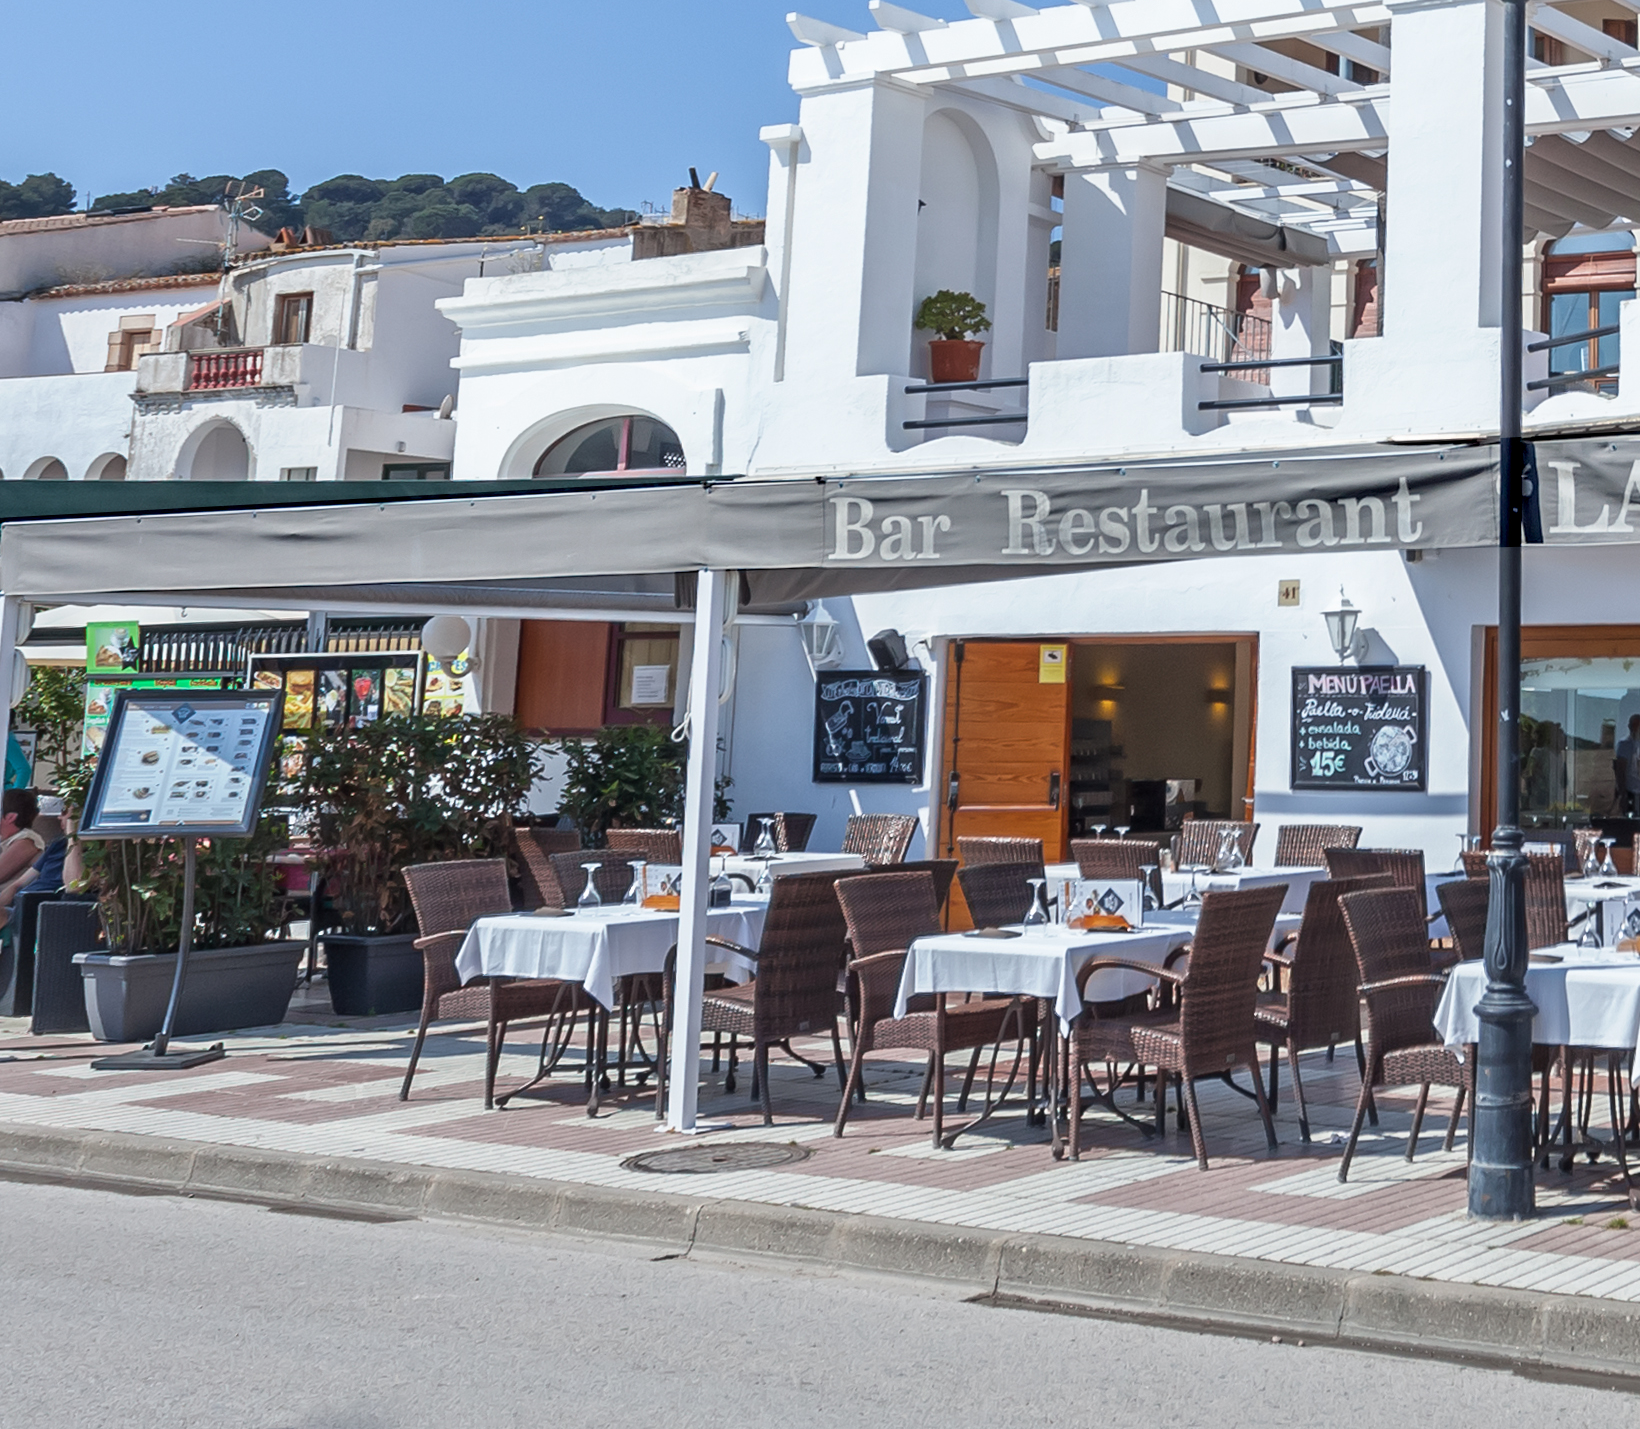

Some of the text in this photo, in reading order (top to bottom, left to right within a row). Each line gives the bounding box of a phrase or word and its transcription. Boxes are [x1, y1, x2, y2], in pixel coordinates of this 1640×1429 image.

[827, 475, 1424, 561] Bar Restaurant
[1307, 673, 1416, 695] MENÚ PAELLA
[1301, 698, 1346, 719] Paella
[1307, 720, 1362, 736] ensalada
[1307, 736, 1353, 751] bebida
[1309, 750, 1347, 777] 15€
